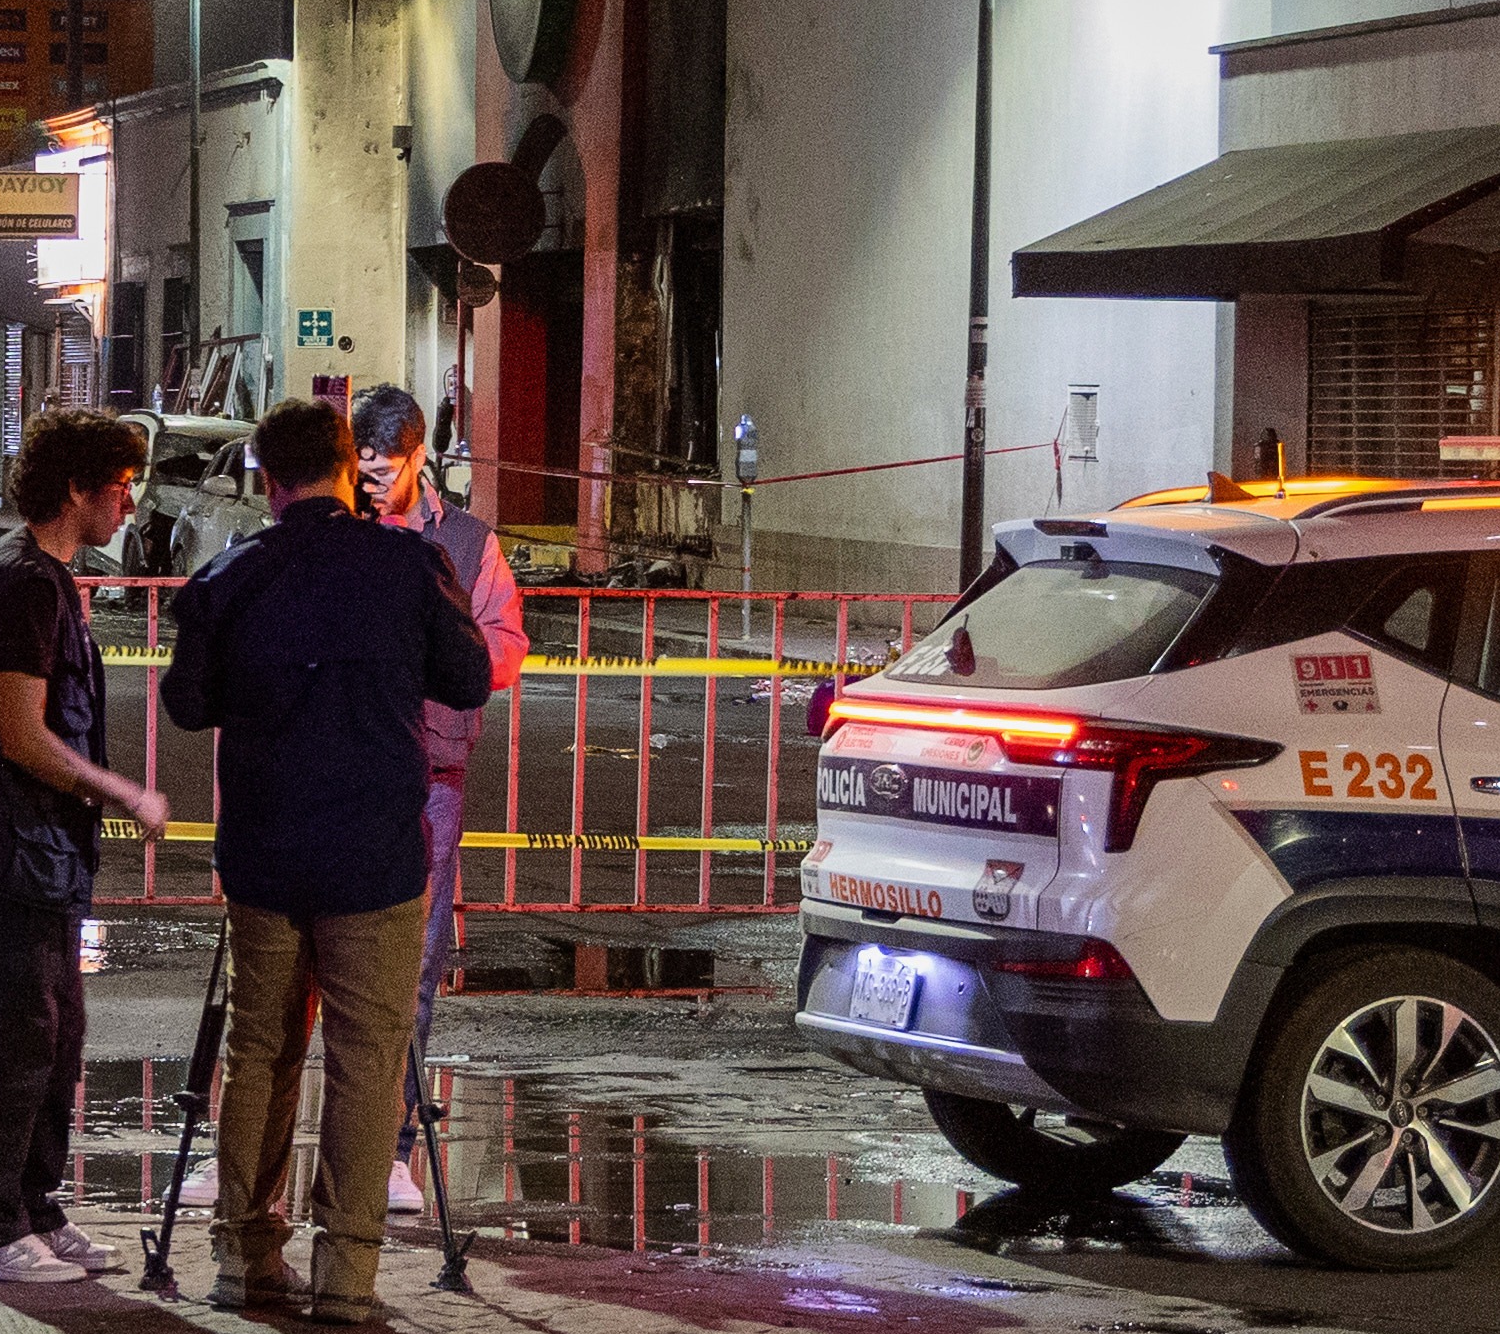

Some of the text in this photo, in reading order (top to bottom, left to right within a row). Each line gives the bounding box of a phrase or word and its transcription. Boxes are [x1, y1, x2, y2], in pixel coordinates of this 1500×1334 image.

[1299, 658, 1367, 679] 911
[1300, 688, 1375, 698] EMERGENCIAS
[817, 766, 866, 807] POLICÍA
[913, 777, 1017, 823] MUNICIPAL
[1298, 750, 1437, 800] E 232
[829, 873, 943, 918] HERMOSILLO
